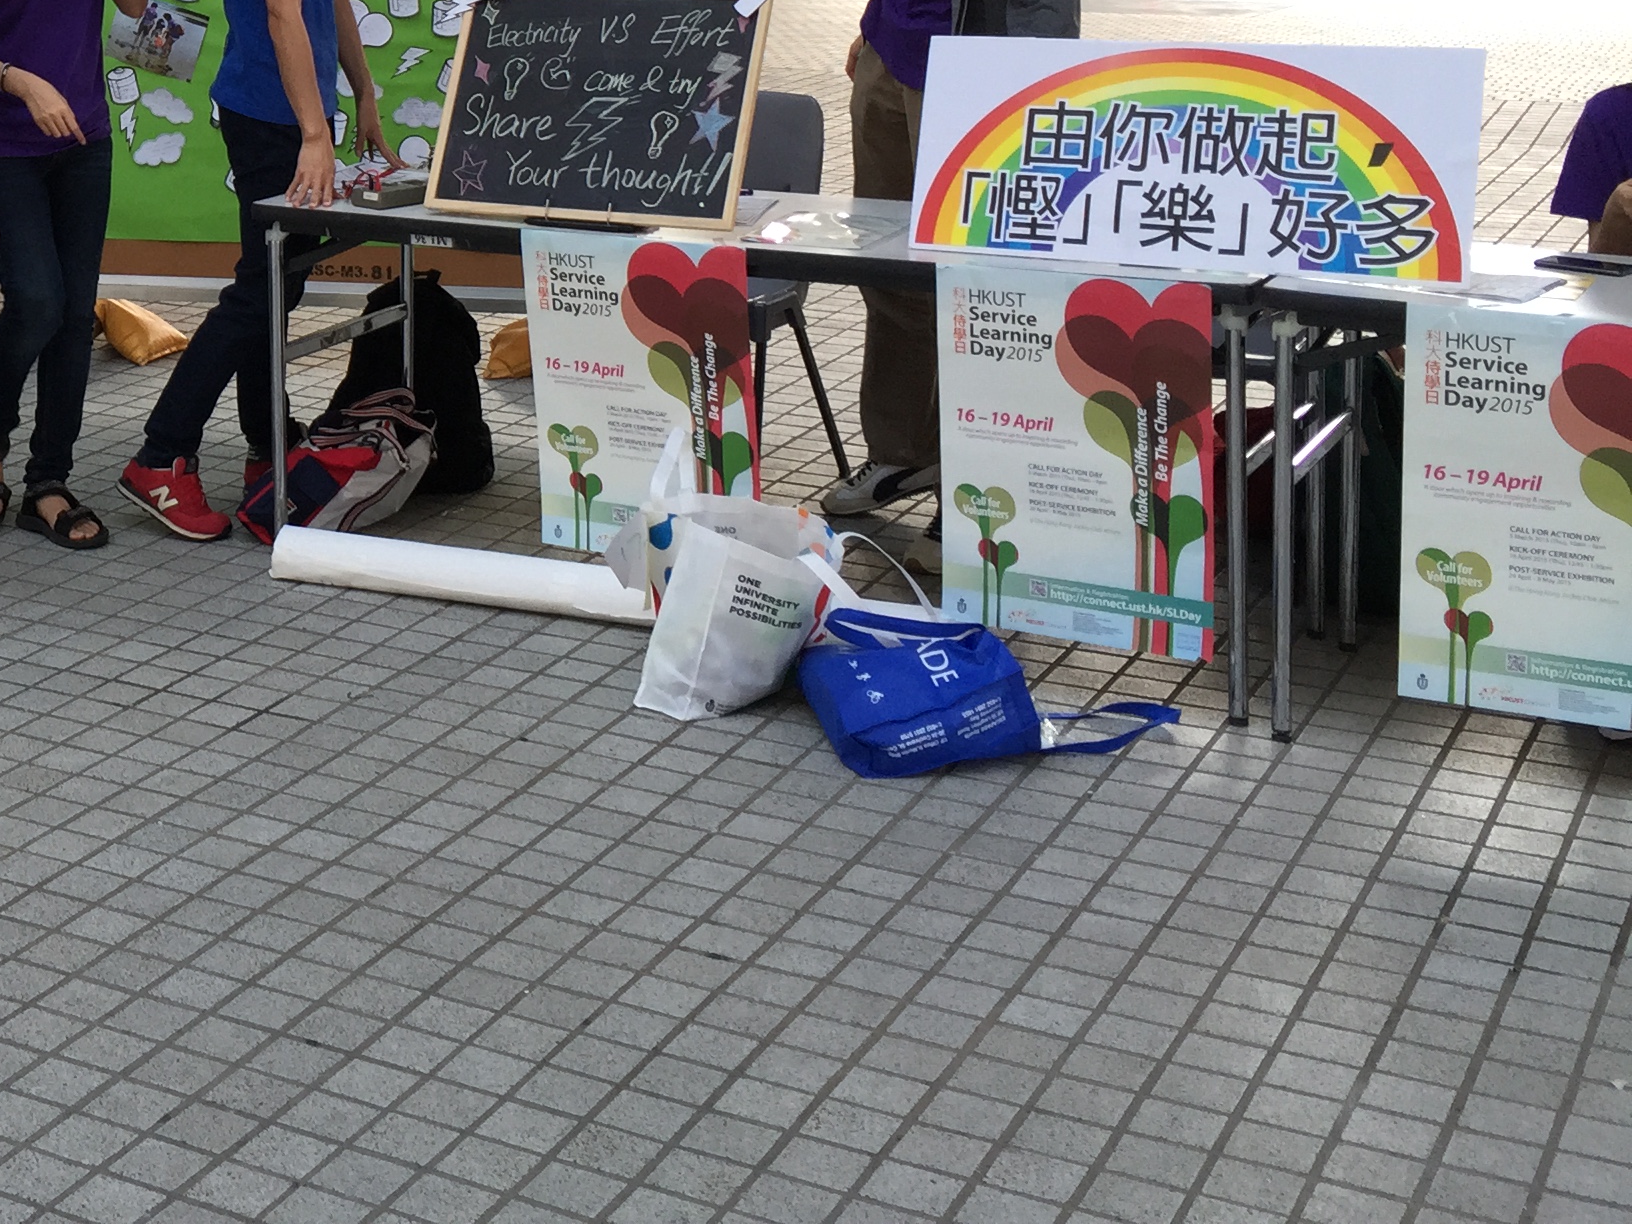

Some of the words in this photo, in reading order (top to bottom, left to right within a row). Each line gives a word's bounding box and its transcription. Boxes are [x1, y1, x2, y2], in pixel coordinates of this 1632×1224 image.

[486, 17, 582, 58] Electricity
[650, 9, 735, 59] Effort
[668, 68, 702, 110] try
[462, 93, 557, 141] Share
[506, 149, 570, 189] Your
[959, 170, 1439, 268] 「慳」「樂」好多
[548, 252, 595, 269] HKUST
[550, 267, 606, 285] Service
[551, 283, 619, 305] Learning
[969, 288, 1026, 307] HKUST
[552, 298, 581, 317] Day
[582, 303, 612, 317] 2015
[969, 306, 1037, 327] Service
[970, 323, 1052, 350] Learning
[1445, 332, 1516, 354] HKUST
[704, 332, 717, 378] Change
[970, 340, 1006, 362] Day
[1006, 346, 1044, 362] 2015
[546, 357, 561, 370] 16
[574, 360, 589, 373] 19
[592, 362, 624, 378] April
[1445, 351, 1528, 375] Service
[691, 356, 702, 415] Difference
[707, 380, 719, 403] The
[1445, 370, 1546, 401] Learning
[1153, 381, 1170, 435] Change
[1444, 389, 1488, 414] Day
[1488, 396, 1534, 415] 2015
[695, 417, 704, 427] a
[708, 408, 719, 421] Be
[956, 408, 975, 423] 16
[992, 411, 1010, 426] 19
[1013, 414, 1054, 433] April
[694, 429, 706, 459] Make
[1134, 407, 1148, 477] Difference
[1154, 436, 1168, 461] The
[1028, 463, 1045, 472] CALL
[1061, 467, 1088, 476] ACTION
[1155, 465, 1168, 482] Be
[1424, 464, 1446, 480] 16
[1466, 469, 1490, 485] 19
[1493, 471, 1543, 493] April
[1138, 478, 1148, 489] a
[970, 494, 987, 507] Call
[988, 496, 1001, 508] for
[1135, 492, 1148, 527] Make
[1510, 525, 1529, 534] CALL
[1532, 528, 1548, 536] FOR
[1551, 530, 1582, 540] ACTION
[1548, 550, 1595, 561] CEREMONY
[1436, 560, 1456, 573] Call
[1457, 562, 1473, 574] for
[737, 574, 762, 588] ONE
[1426, 569, 1483, 588] Volunteers
[1568, 572, 1615, 585] EXHIBITION
[732, 595, 779, 616] INFINITE
[735, 584, 800, 610] UNIVERSITY
[1050, 589, 1202, 624] http://connect.ust.hk/SLDay
[729, 605, 803, 629] POSSIBILITIES
